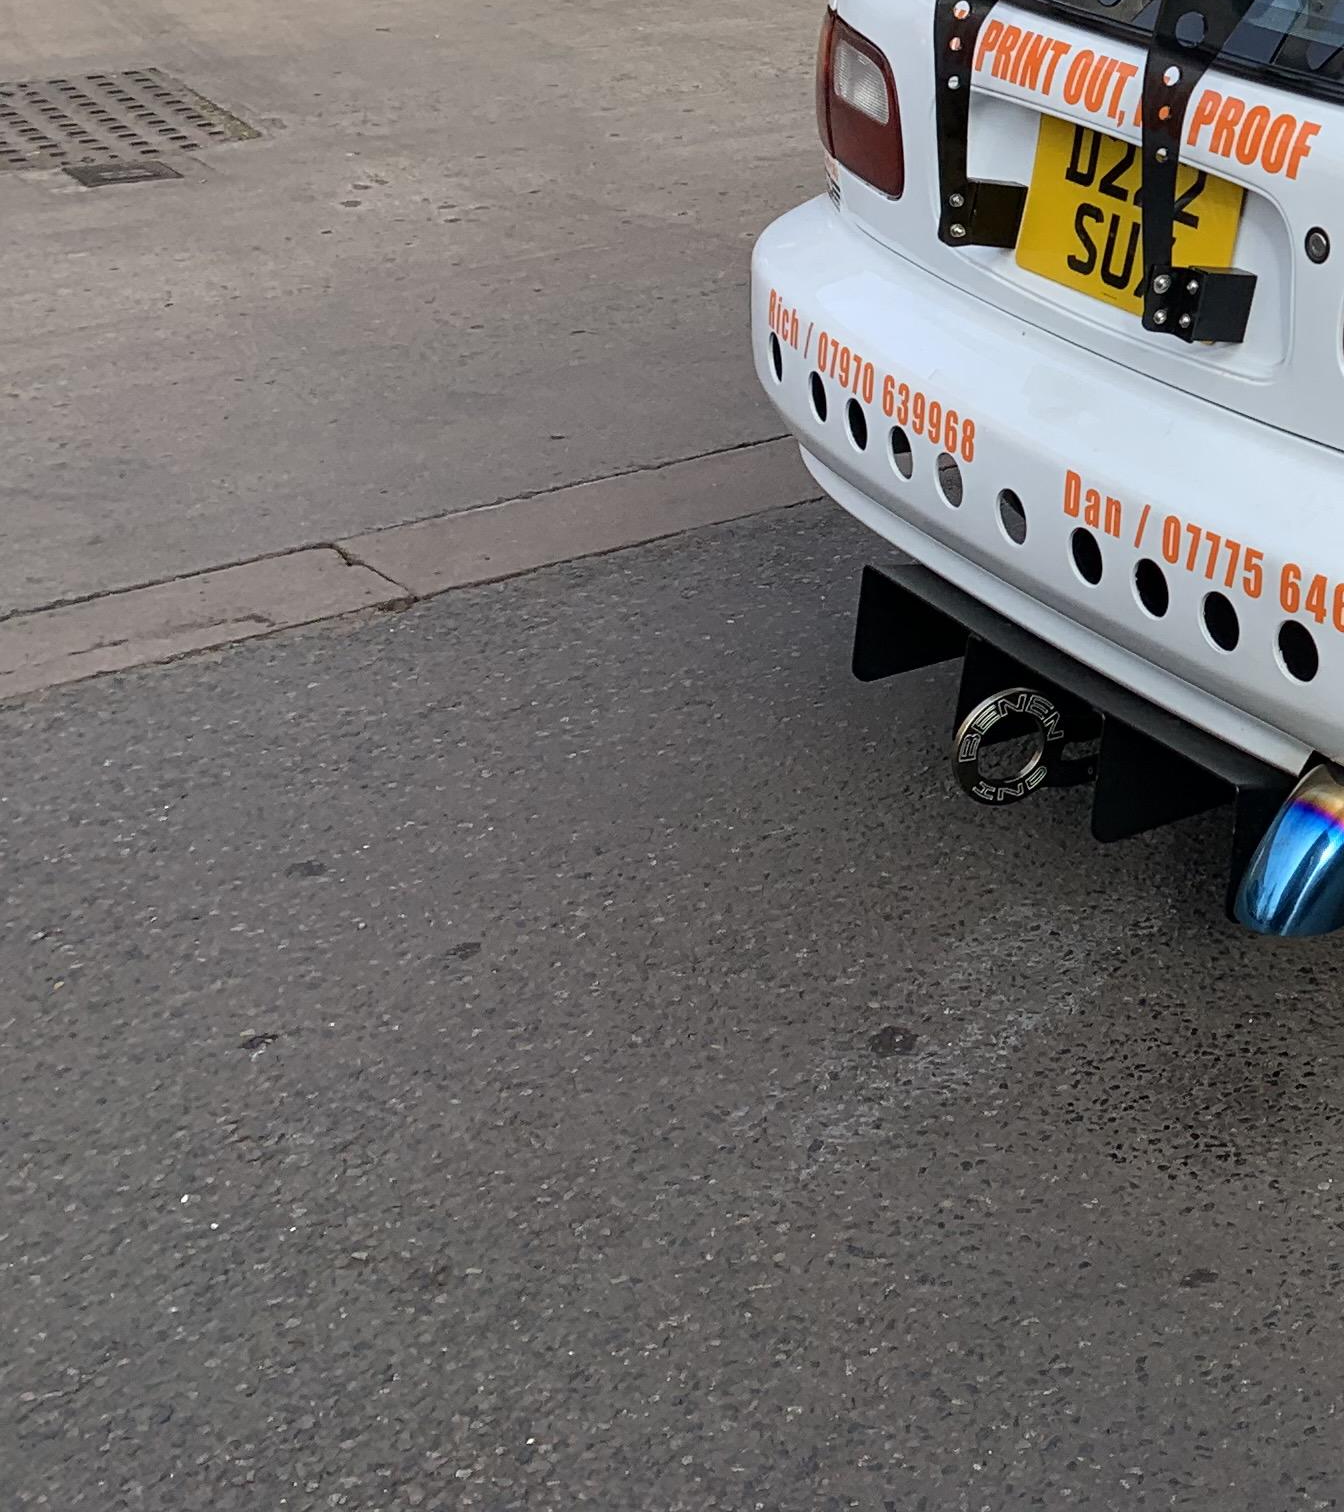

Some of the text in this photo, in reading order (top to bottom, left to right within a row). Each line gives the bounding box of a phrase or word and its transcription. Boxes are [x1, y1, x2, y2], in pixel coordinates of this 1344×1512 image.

[975, 19, 1071, 101] PRINT
[1186, 89, 1322, 180] PROOF
[1065, 123, 1208, 229] D22
[769, 289, 799, 350] Rich
[817, 331, 874, 404] 07970
[882, 374, 975, 463] 639968
[1064, 469, 1122, 539] Dan
[1162, 515, 1264, 599] 07775
[958, 693, 1064, 763] BENEN
